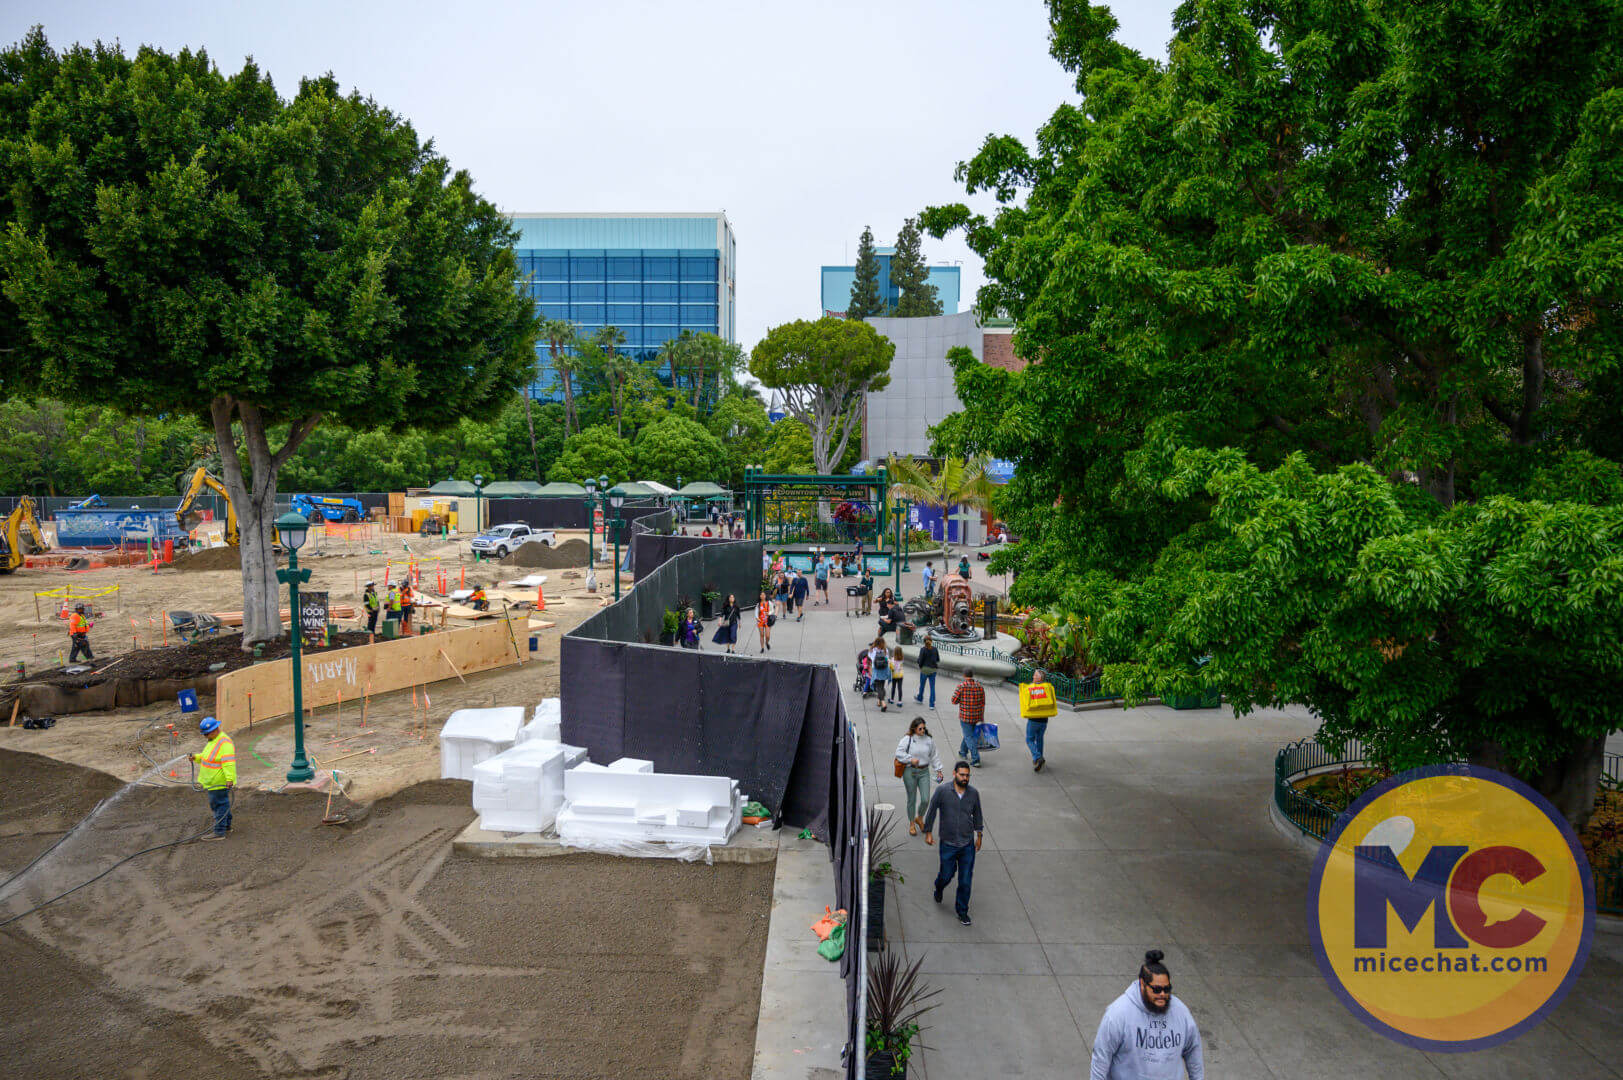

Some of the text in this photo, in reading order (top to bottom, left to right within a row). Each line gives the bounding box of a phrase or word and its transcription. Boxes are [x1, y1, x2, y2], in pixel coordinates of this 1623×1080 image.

[303, 607, 325, 616] FOOD
[303, 618, 325, 627] WINE
[1136, 1026, 1181, 1050] Modelo
